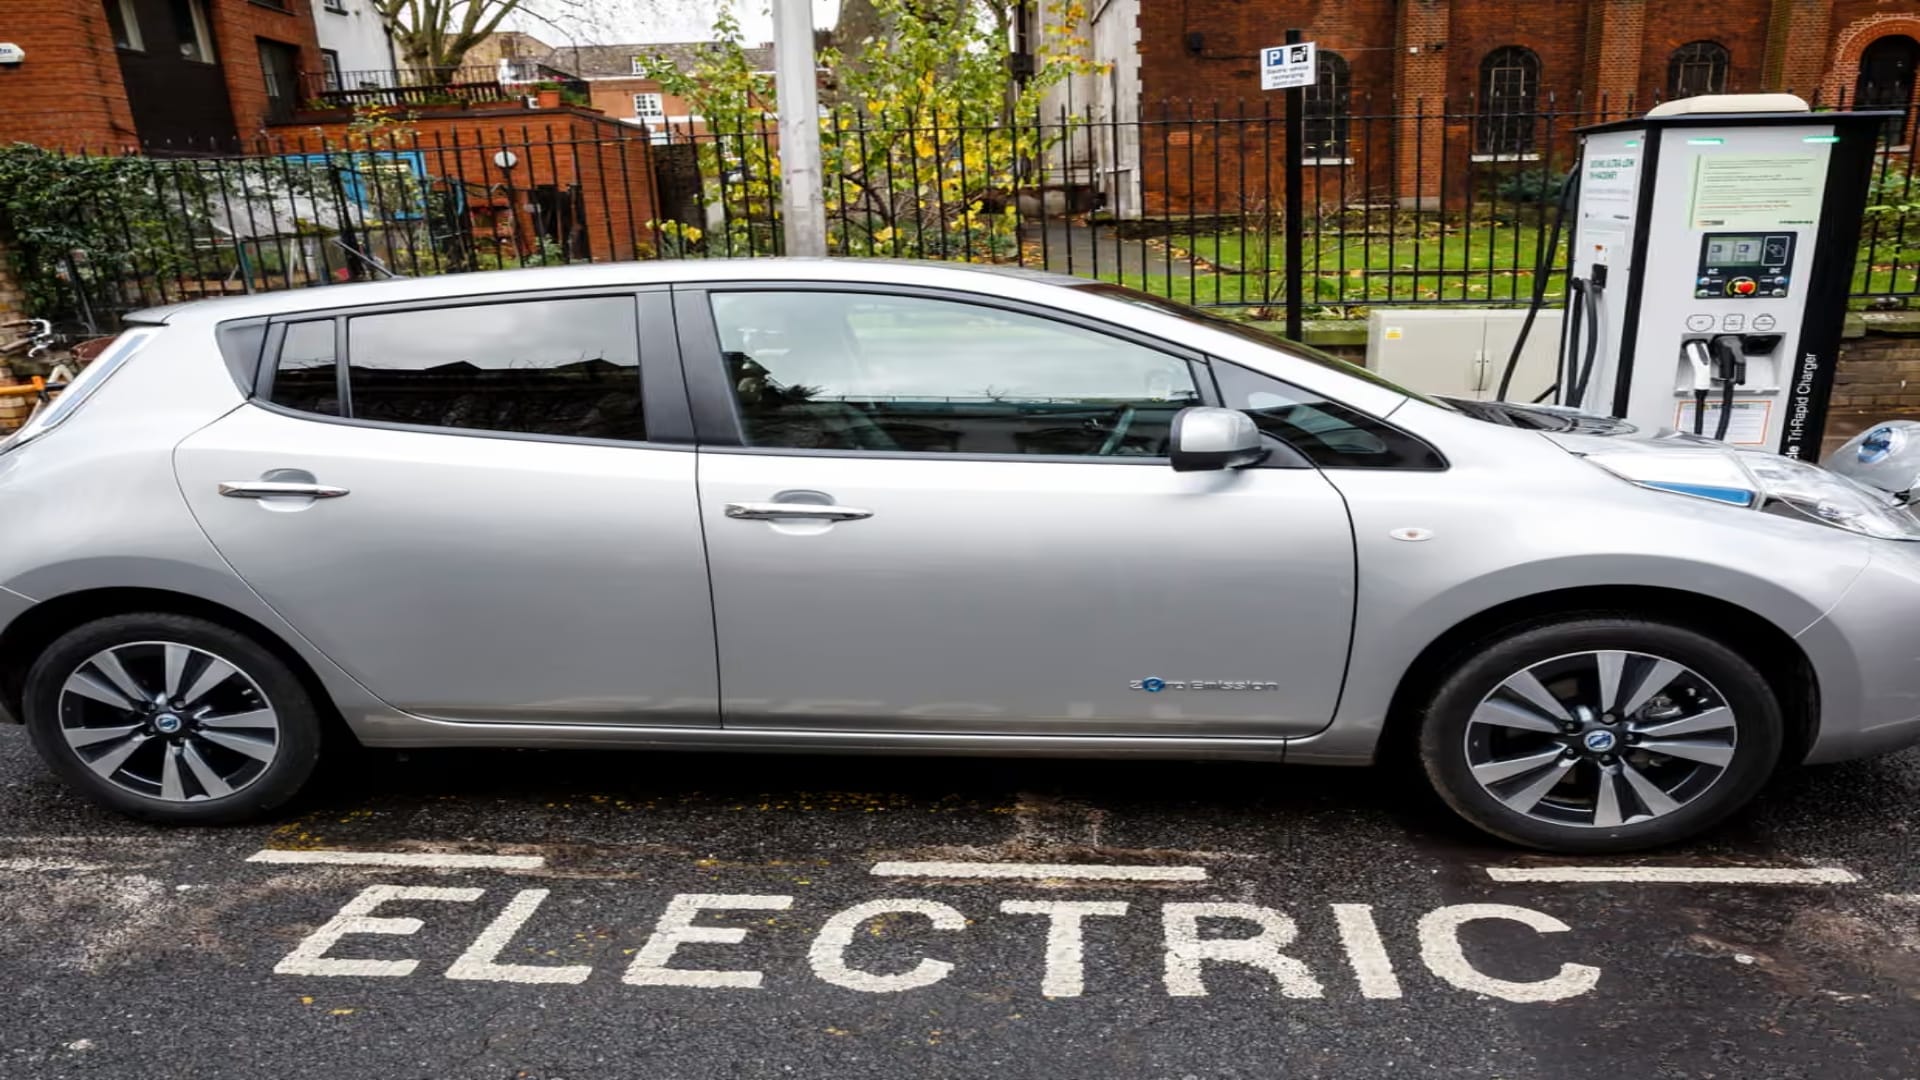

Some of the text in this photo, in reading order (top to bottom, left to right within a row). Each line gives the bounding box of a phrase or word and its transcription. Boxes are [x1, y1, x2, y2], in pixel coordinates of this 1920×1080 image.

[1269, 50, 1281, 65] P
[1796, 353, 1818, 394] Charger
[1787, 397, 1809, 441] Tri-Rapid
[1190, 679, 1280, 691] Emission
[274, 885, 1600, 1003] ELECTRIC
